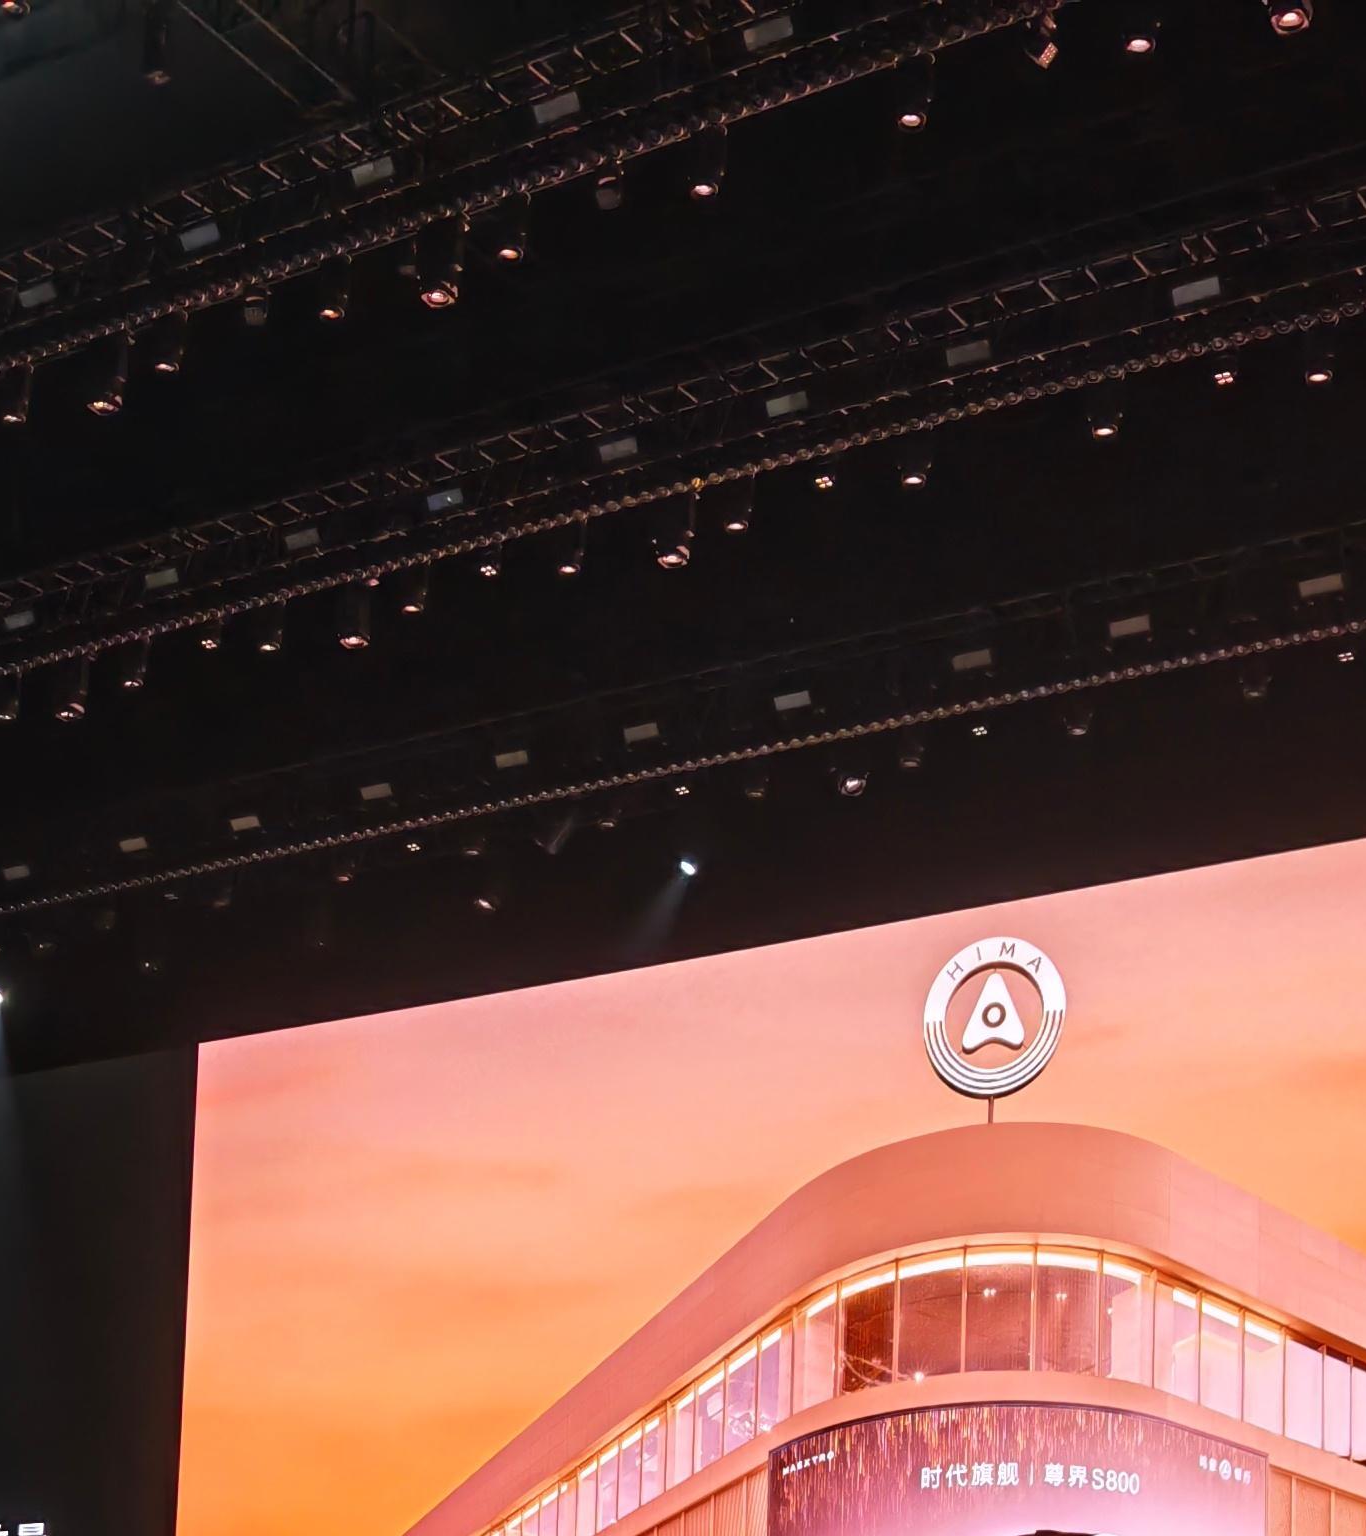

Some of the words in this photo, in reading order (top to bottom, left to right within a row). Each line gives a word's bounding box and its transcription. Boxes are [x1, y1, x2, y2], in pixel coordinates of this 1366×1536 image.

[946, 940, 1043, 981] HIMA
[920, 1462, 1019, 1489] 时代旗舰
[1044, 1463, 1140, 1495] 尊界S800
